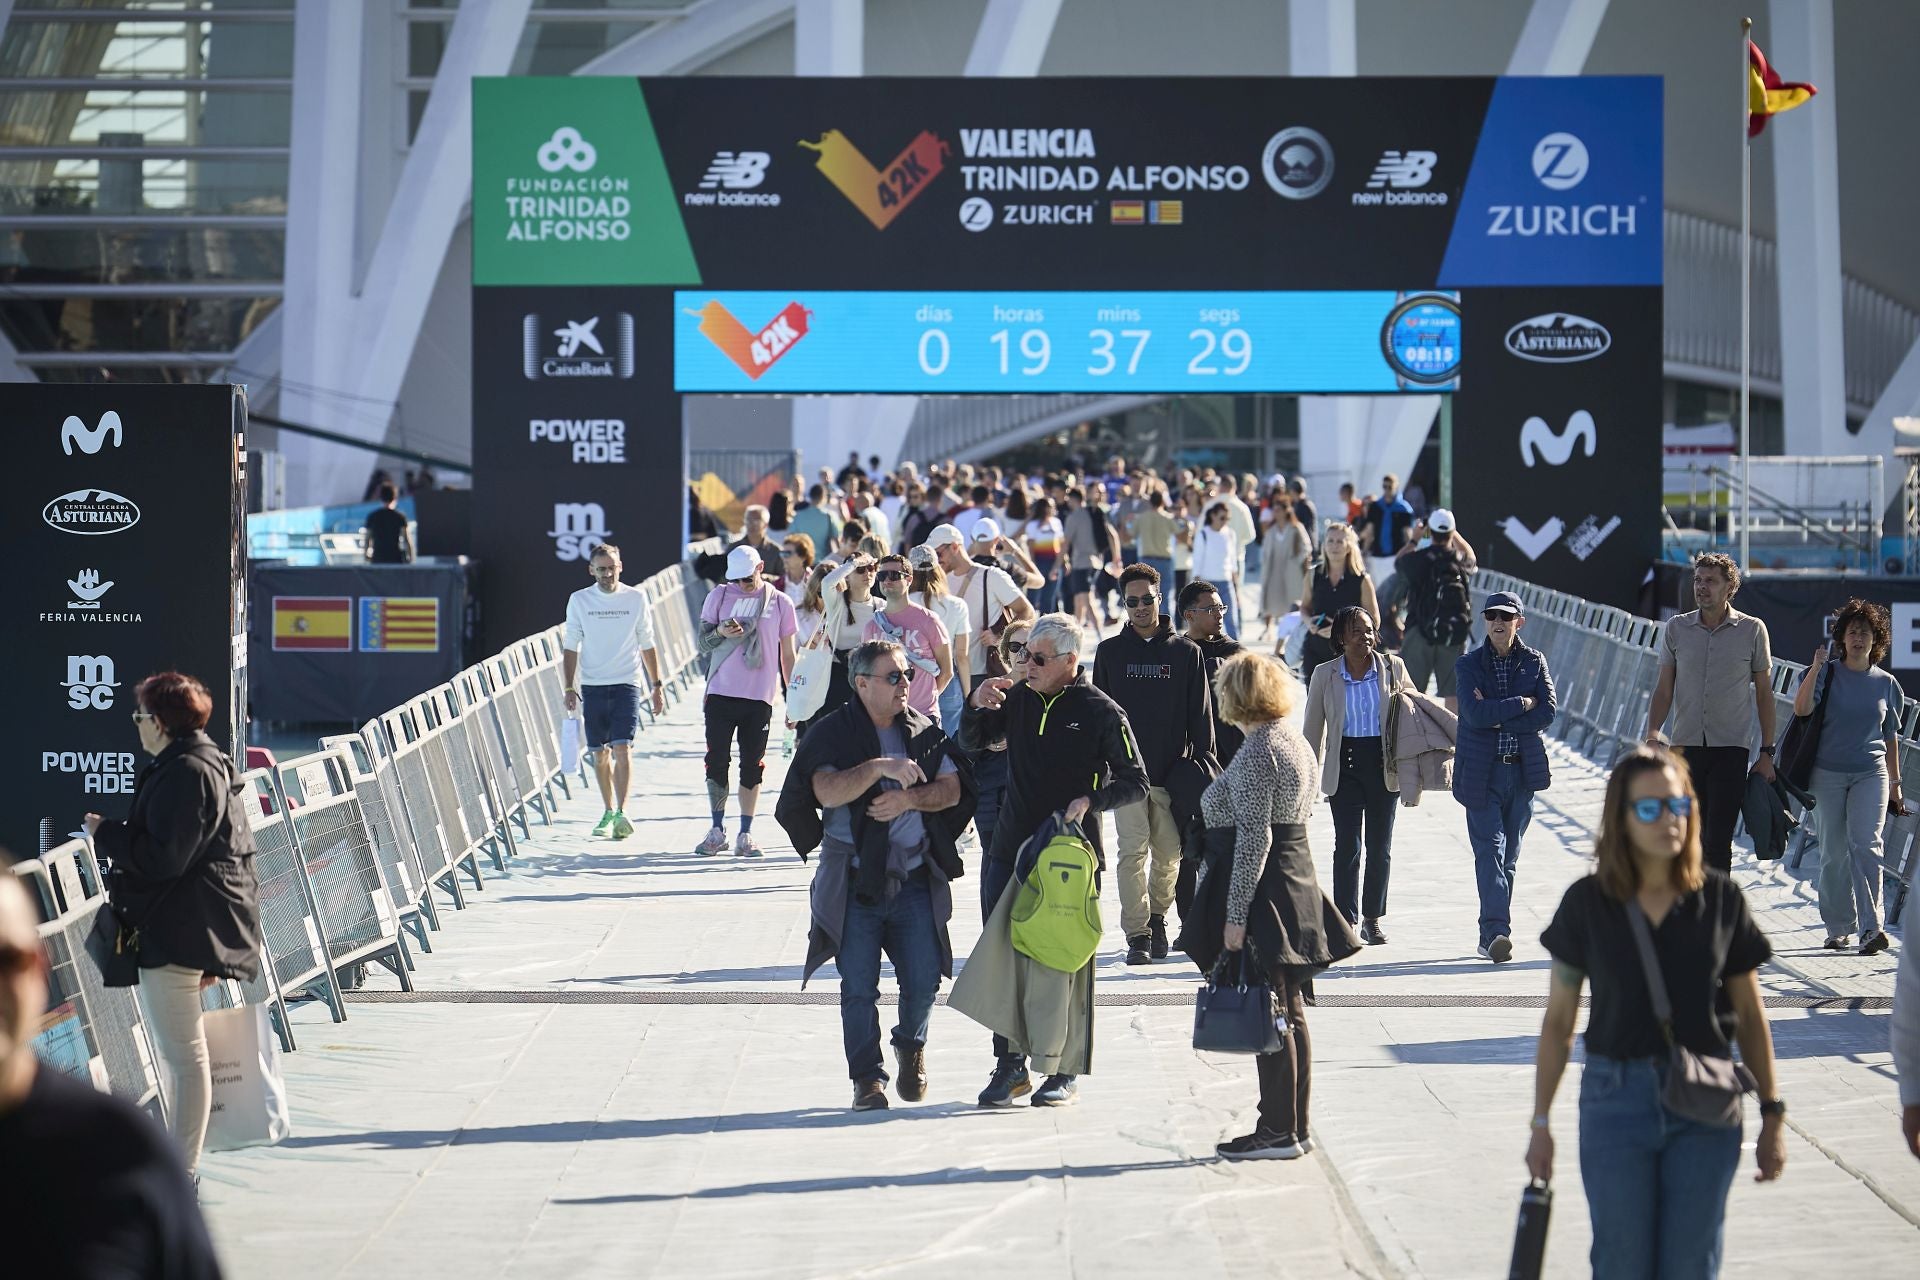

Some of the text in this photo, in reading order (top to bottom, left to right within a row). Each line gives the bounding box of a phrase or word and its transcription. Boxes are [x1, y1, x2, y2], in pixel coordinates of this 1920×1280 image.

[960, 128, 1096, 158] VALENCIA
[507, 175, 629, 192] FUNDACIÓN
[875, 153, 930, 212] 42K
[960, 165, 1250, 192] TRINIDAD ALFONSO
[506, 196, 630, 218] TRINIDAD
[684, 190, 781, 206] new balance
[1352, 190, 1447, 206] new balance
[1003, 204, 1093, 226] ZURICH
[1487, 204, 1636, 237] ZURICH
[506, 219, 631, 242] ALFONSO
[916, 304, 953, 322] días
[993, 304, 1045, 322] horas
[1097, 304, 1142, 322] mins
[1199, 307, 1241, 328] segs
[749, 314, 799, 367] 42K
[918, 328, 951, 376] 0
[989, 328, 1052, 376] 19
[1087, 328, 1152, 376] 37
[1187, 328, 1252, 376] 29
[542, 360, 615, 377] CaixaBank
[529, 419, 625, 442] POWER
[572, 441, 627, 463] ADE
[39, 613, 142, 622] FERIA VALENCIA
[730, 597, 774, 619] NIE
[42, 751, 135, 773] POWER
[84, 773, 135, 794] ADE
